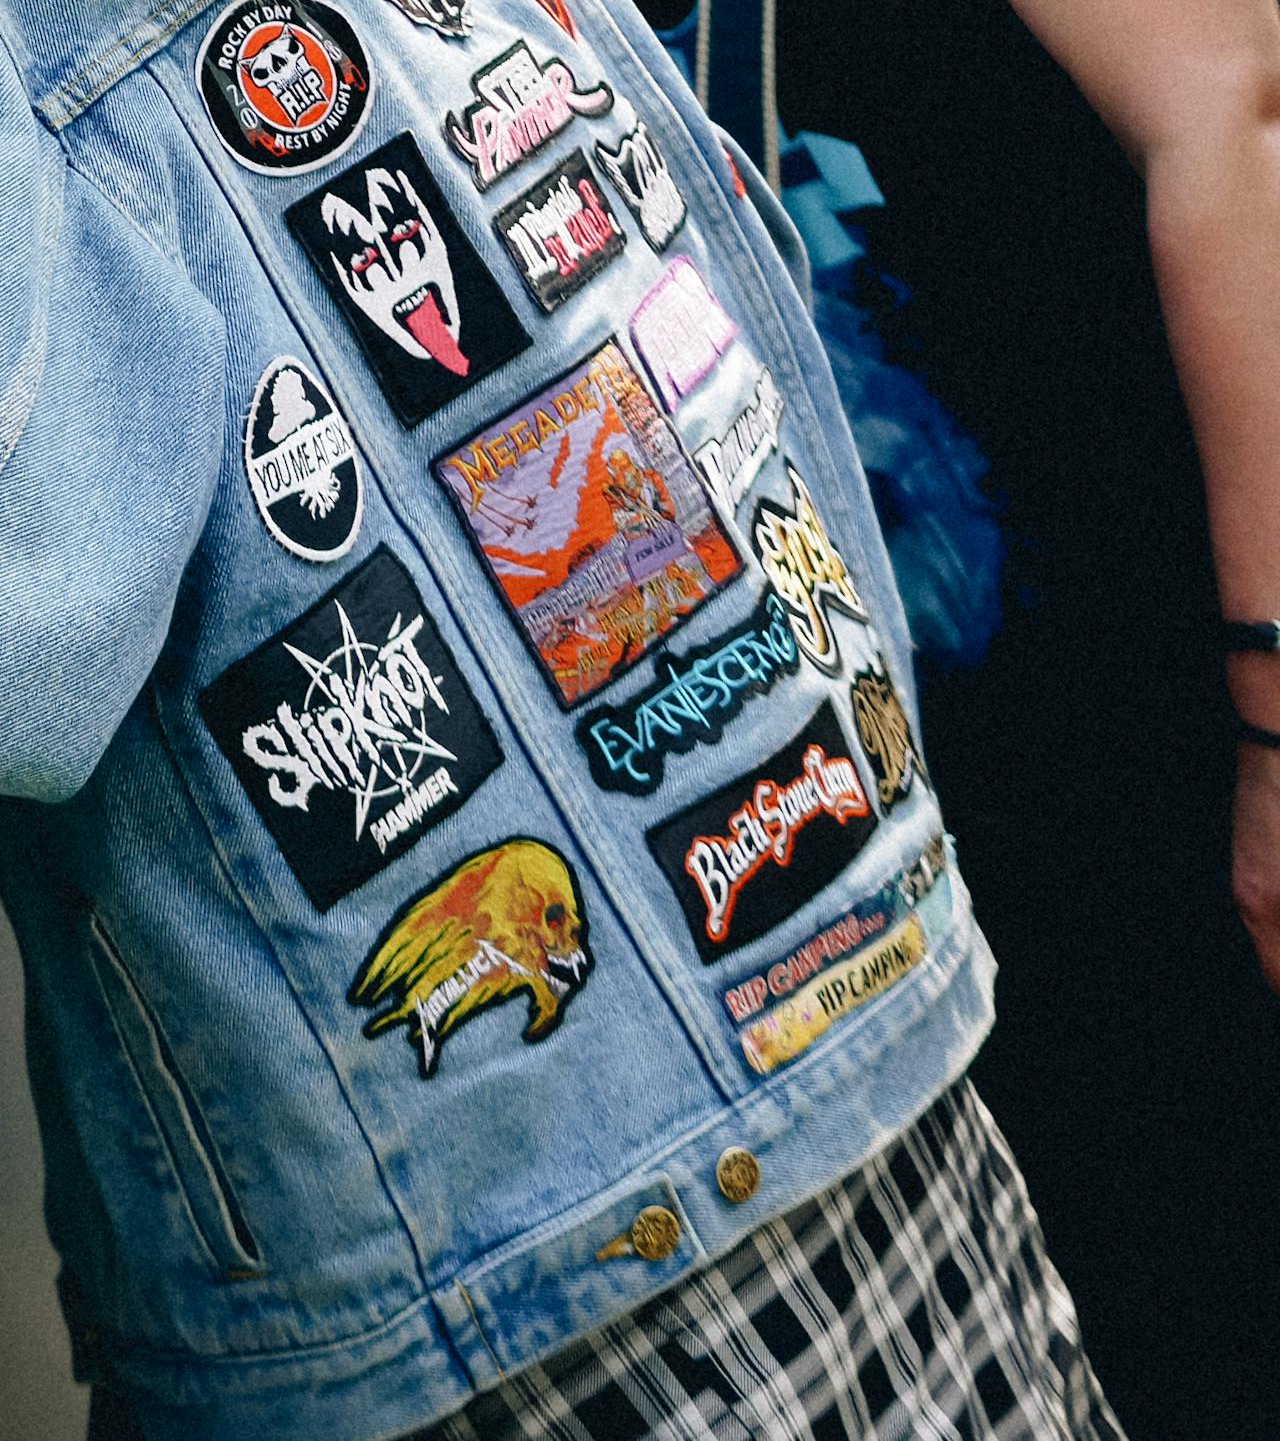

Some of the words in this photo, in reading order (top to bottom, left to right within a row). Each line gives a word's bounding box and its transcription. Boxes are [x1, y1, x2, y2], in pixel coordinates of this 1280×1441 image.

[218, 23, 247, 71] ROCK
[242, 9, 263, 29] BY
[263, 5, 293, 22] DAY
[274, 132, 310, 151] REST
[310, 124, 330, 145] BY
[328, 81, 352, 132] NIGHT
[254, 454, 291, 499] YOU
[288, 441, 316, 484] ME
[311, 432, 331, 470] AT
[325, 419, 351, 457] SIX
[447, 365, 641, 514] MEGADETH
[590, 593, 798, 782] EVANESCENCE
[369, 765, 460, 856] HAMMER
[415, 938, 536, 1074] METALLICA
[724, 974, 768, 1022] RIP
